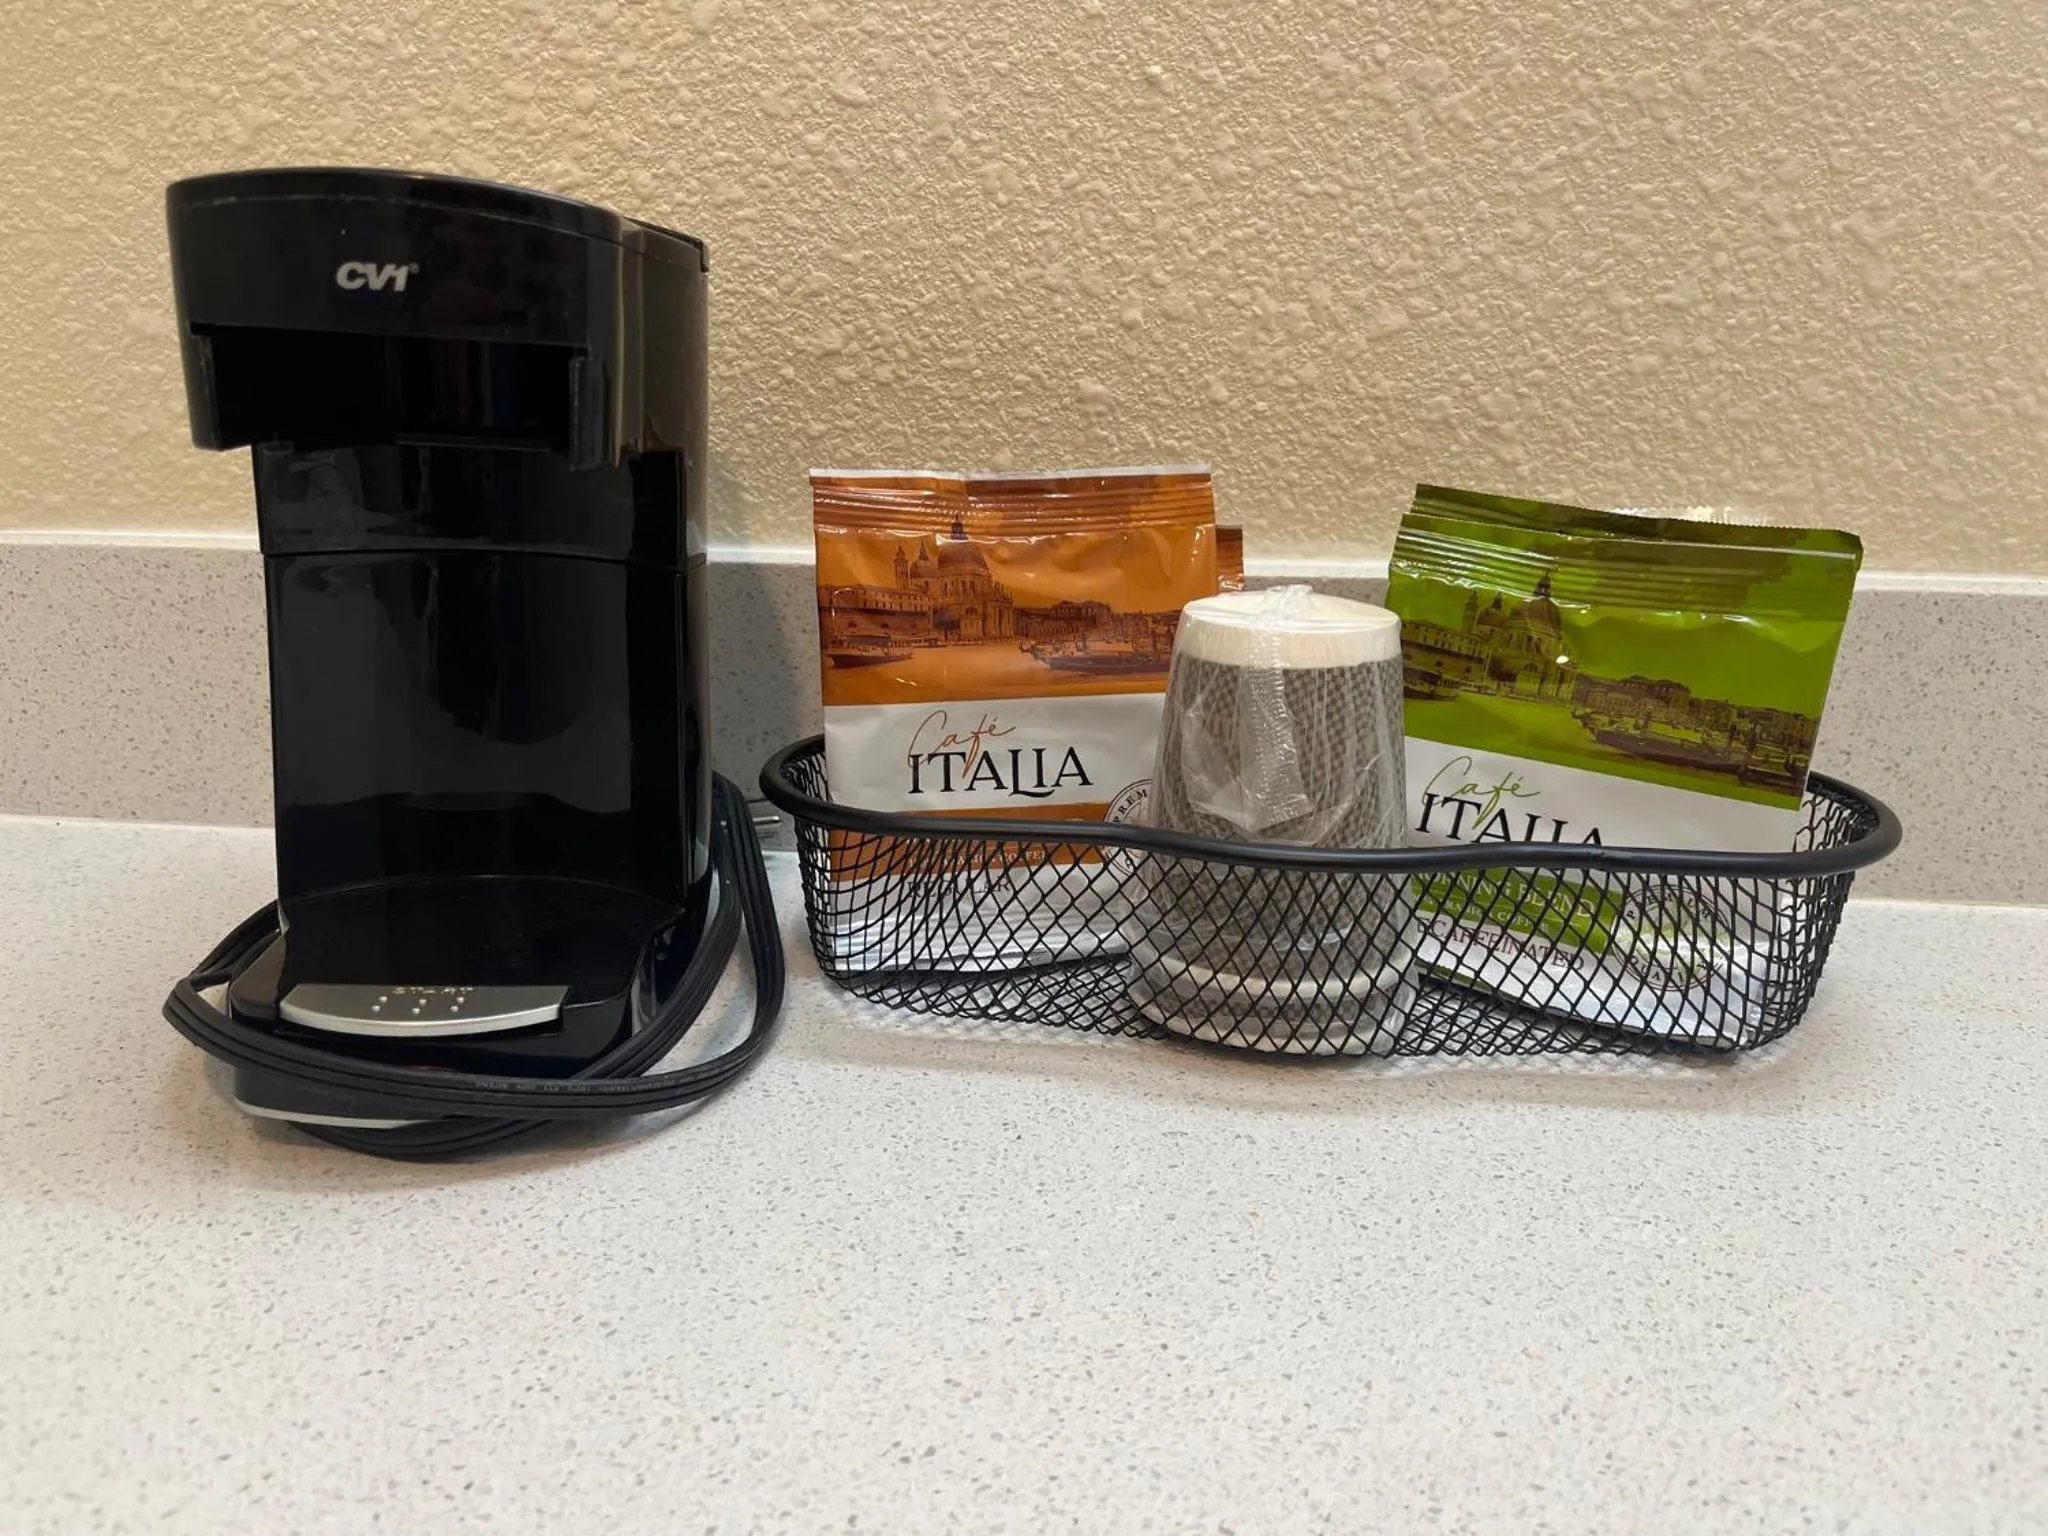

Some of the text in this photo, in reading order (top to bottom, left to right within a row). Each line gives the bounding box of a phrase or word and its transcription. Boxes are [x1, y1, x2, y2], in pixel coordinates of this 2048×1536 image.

[906, 710, 1017, 779] Café
[907, 746, 1094, 798] ITALIA
[1421, 756, 1541, 830] Café
[907, 876, 1011, 897] REGLAR
[1417, 917, 1585, 970] ECAFFEINATED
